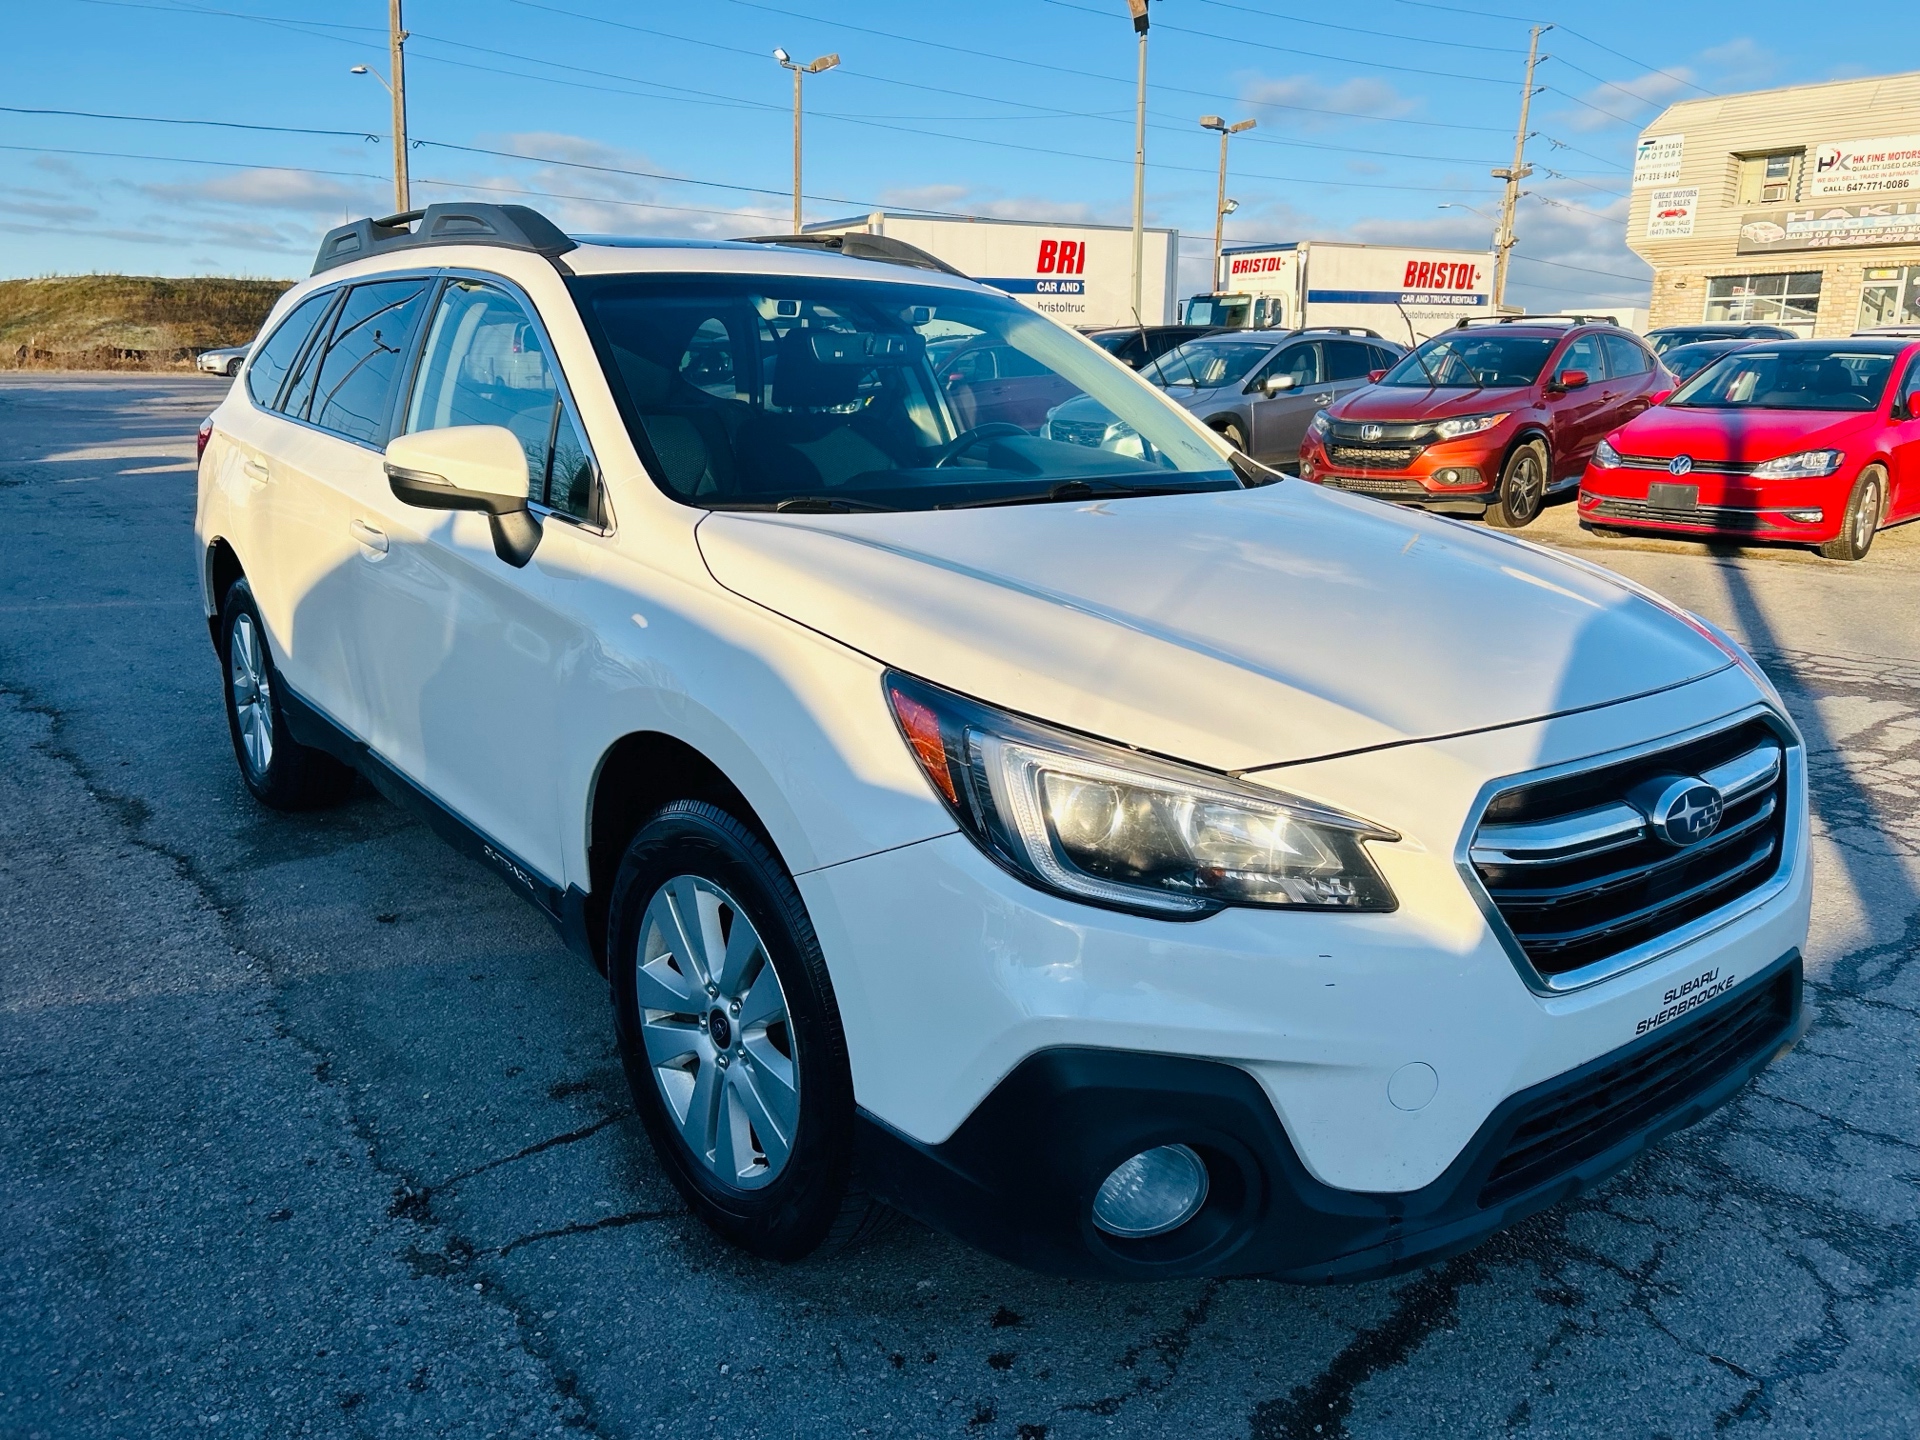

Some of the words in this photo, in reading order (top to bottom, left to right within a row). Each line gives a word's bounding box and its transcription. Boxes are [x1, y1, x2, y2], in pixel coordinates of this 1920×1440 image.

[1643, 150, 1682, 161] MOTORS
[1852, 155, 1866, 165] HK
[1866, 153, 1886, 163] FINE
[1851, 164, 1881, 173] QUALITY
[1882, 163, 1901, 171] USED
[1823, 185, 1846, 193] CALL:
[1846, 179, 1910, 193] 647-771-0086
[1653, 191, 1673, 200] GREAT
[1673, 189, 1698, 199] MOTORS
[1657, 200, 1672, 208] AUTO
[1673, 199, 1691, 207] SALES
[1787, 203, 1920, 222] HAKI
[1788, 217, 1864, 233] AUTO
[1786, 231, 1813, 240] SALES
[1815, 230, 1829, 238] OF
[1829, 229, 1848, 237] ALL
[1849, 227, 1884, 236] MAKES
[1885, 226, 1906, 234] AND
[1037, 239, 1085, 274] BRI
[1231, 256, 1281, 274] BRISTOL
[1403, 260, 1476, 290] BRISTOL
[1036, 281, 1058, 293] CAR
[1060, 282, 1080, 293] AND
[1401, 294, 1416, 303] CAR
[1416, 294, 1430, 304] AND
[1430, 295, 1451, 304] TRUCK
[1451, 295, 1478, 305] RENTALS
[1663, 967, 1720, 1006] SUBARU
[1635, 975, 1735, 1036] SHERBROOKE
